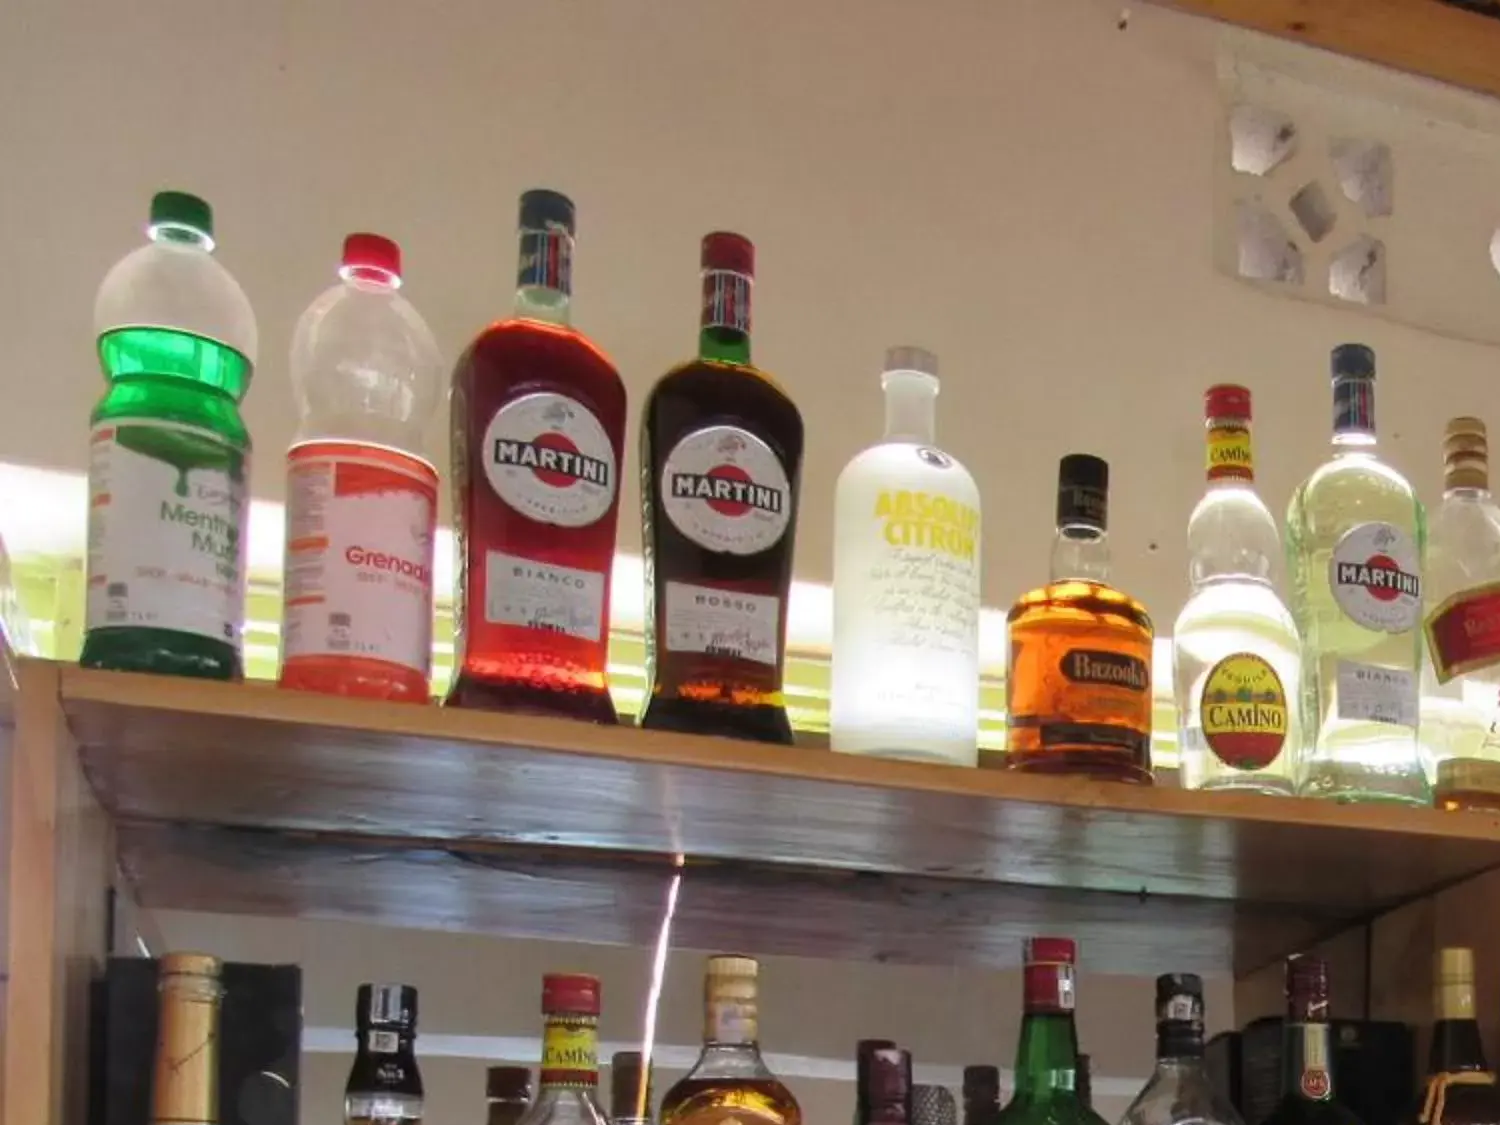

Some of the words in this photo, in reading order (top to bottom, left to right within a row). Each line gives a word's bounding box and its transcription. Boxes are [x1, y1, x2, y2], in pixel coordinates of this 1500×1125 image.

[500, 442, 606, 483] MARTINI
[676, 476, 779, 512] MARTINI
[512, 566, 586, 590] BIANCO
[1341, 564, 1418, 596] MARTINI
